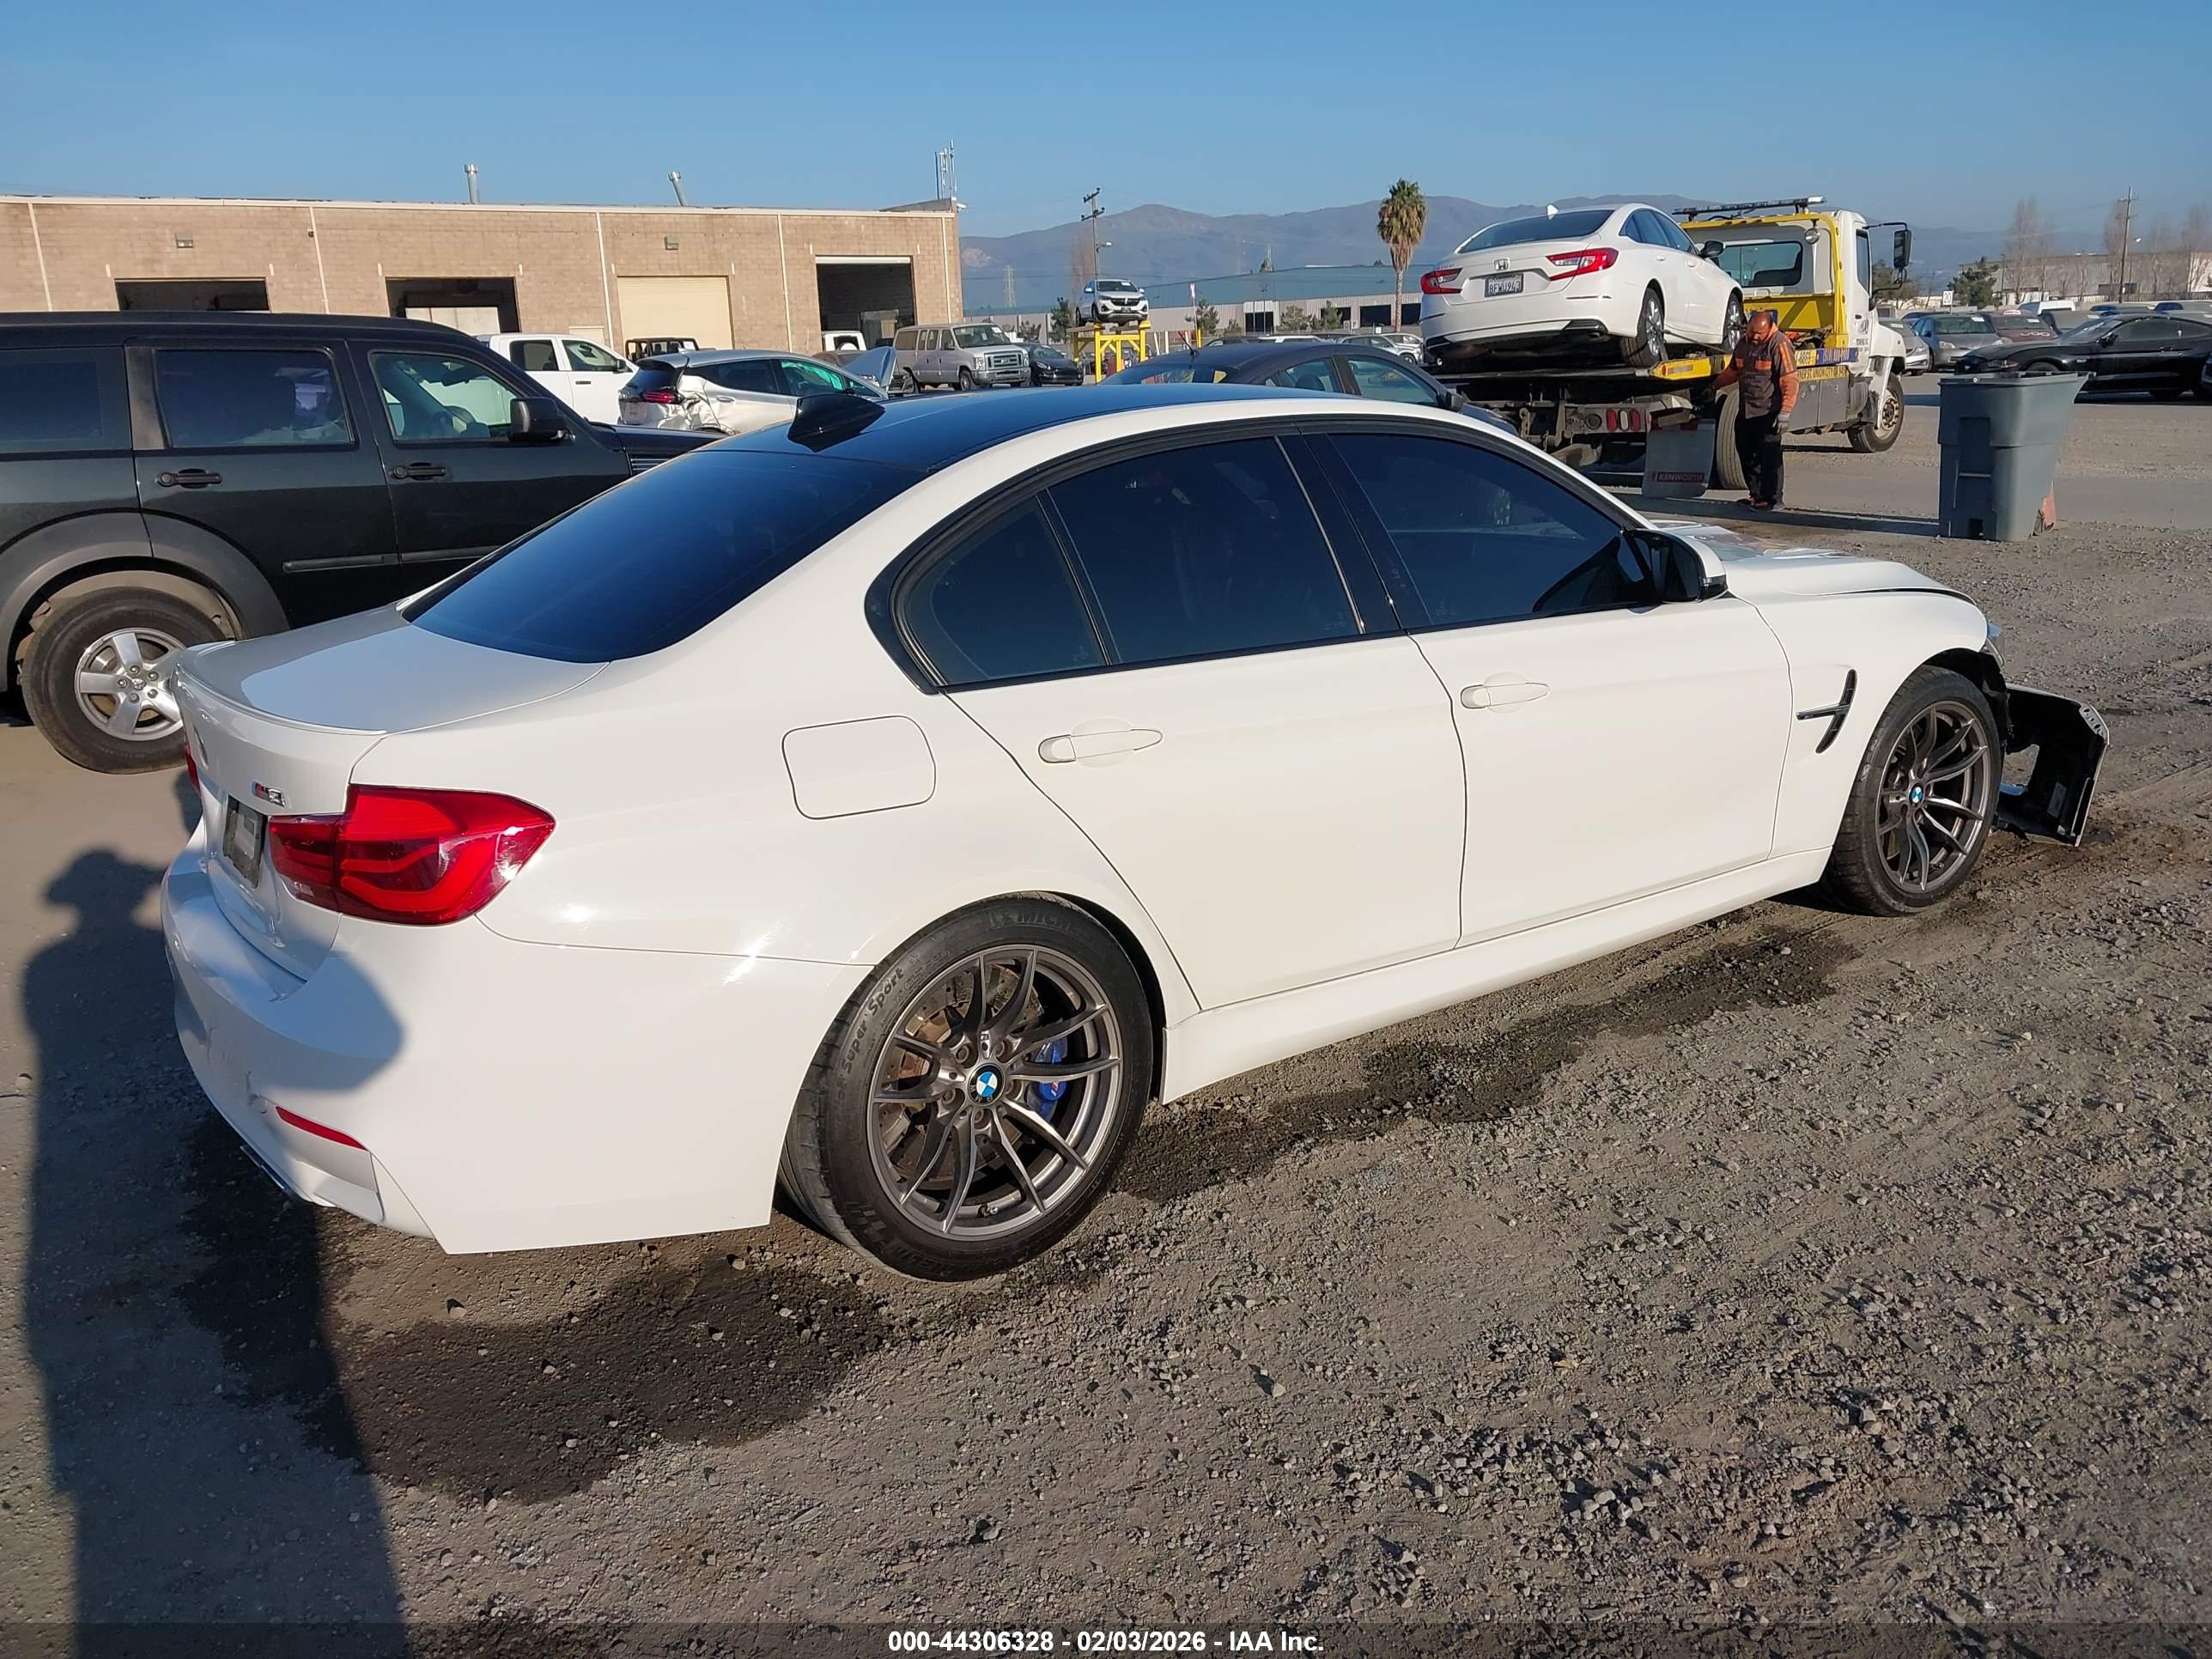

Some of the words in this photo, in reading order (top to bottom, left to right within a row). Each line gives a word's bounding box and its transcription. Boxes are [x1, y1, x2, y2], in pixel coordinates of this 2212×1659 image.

[1658, 472, 1704, 481] KENWORTH
[841, 1019, 867, 1074] Super
[868, 968, 904, 1016] Sport
